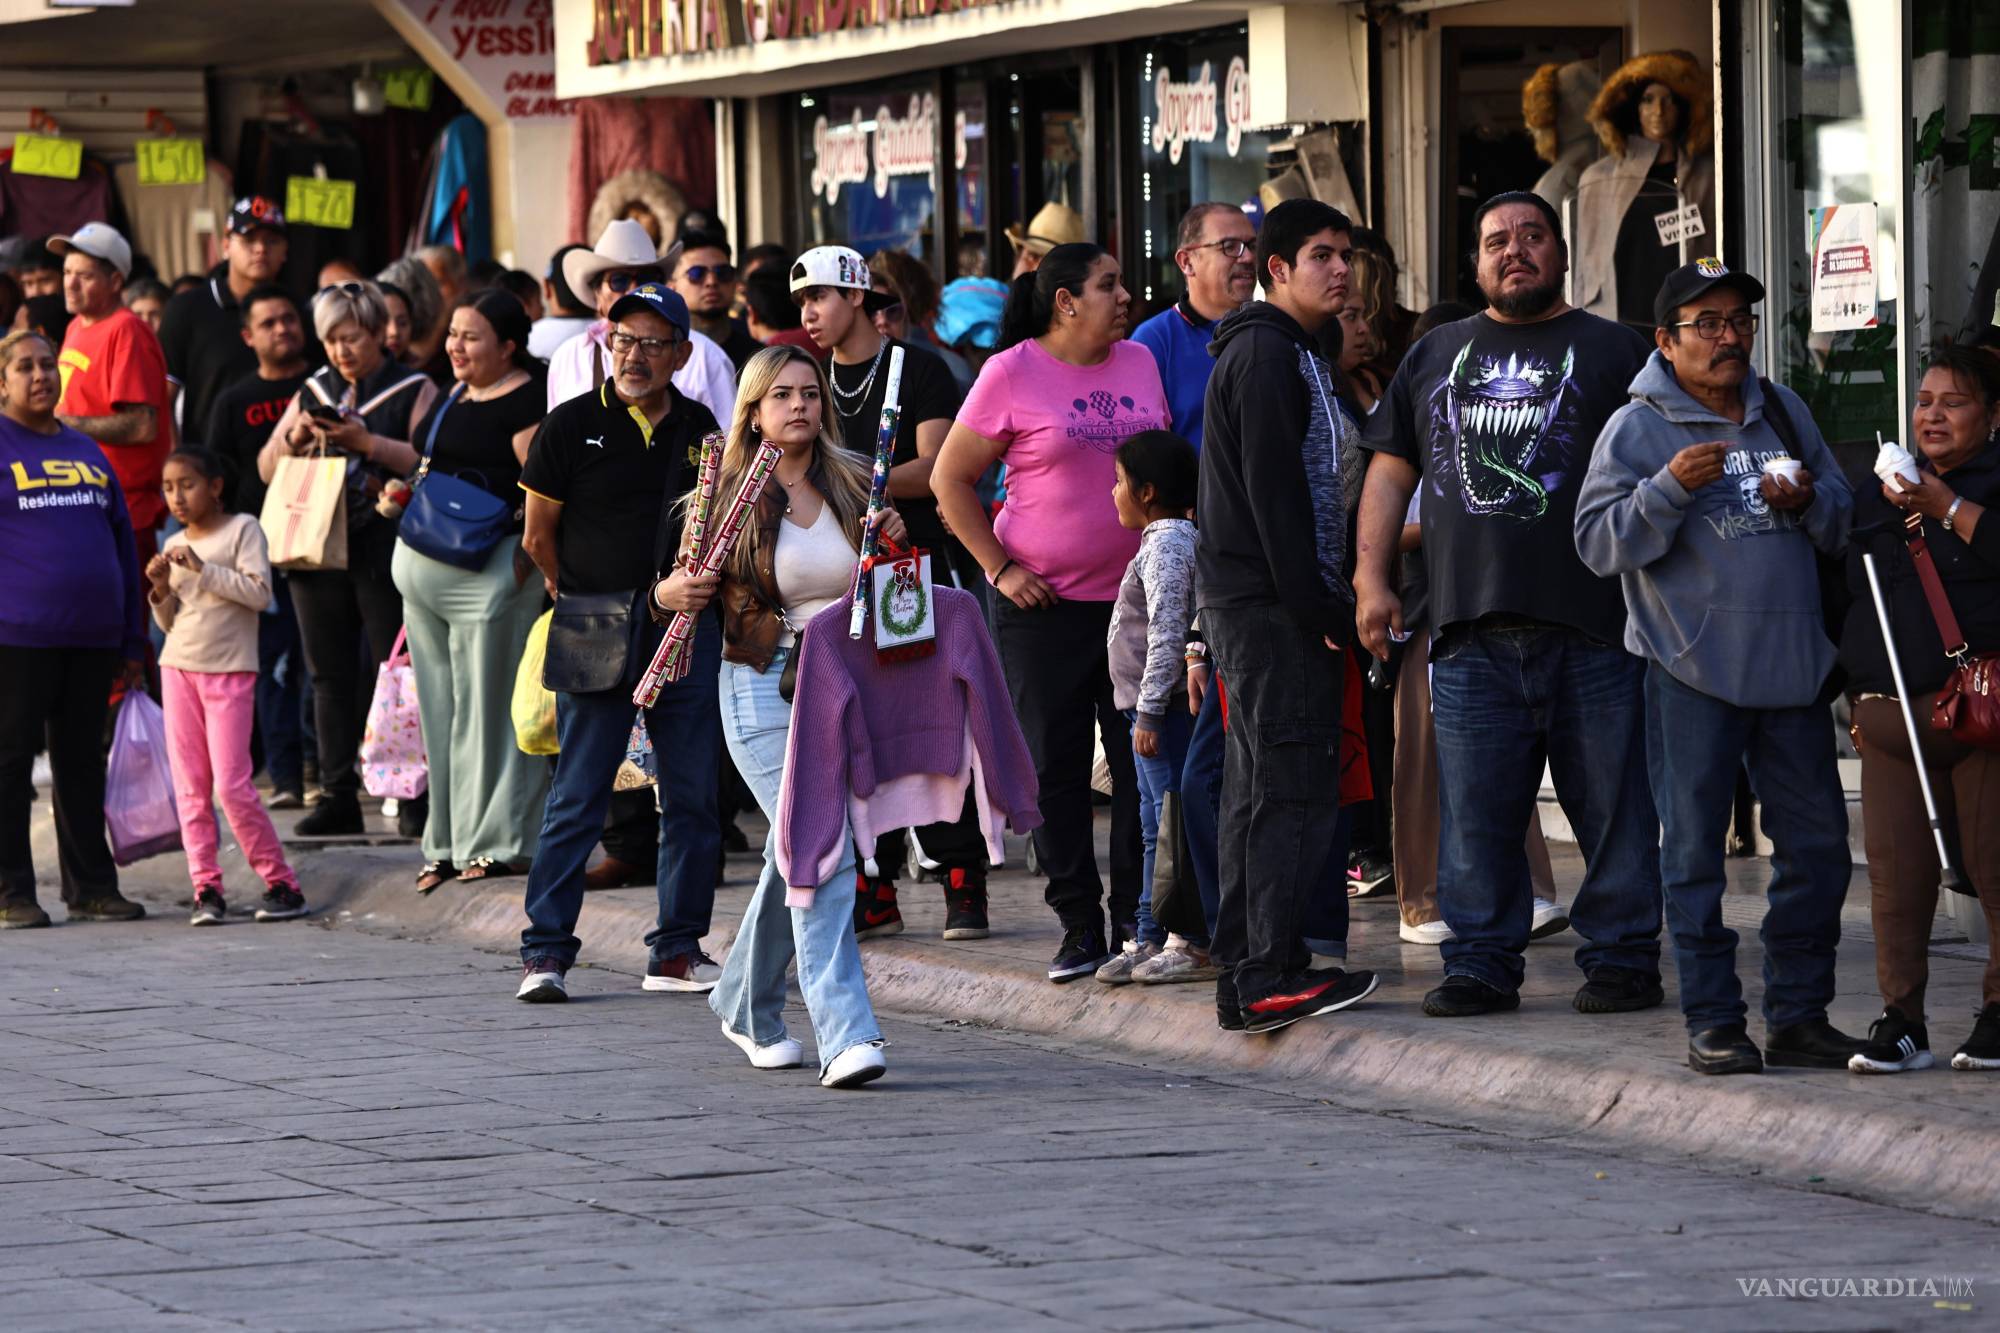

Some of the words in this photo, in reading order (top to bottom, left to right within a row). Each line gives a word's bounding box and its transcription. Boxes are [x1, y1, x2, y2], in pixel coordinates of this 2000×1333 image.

[139, 138, 200, 184] 150
[1067, 426, 1118, 438] BALLOON
[10, 459, 108, 491] LSU
[18, 489, 95, 510] Residential
